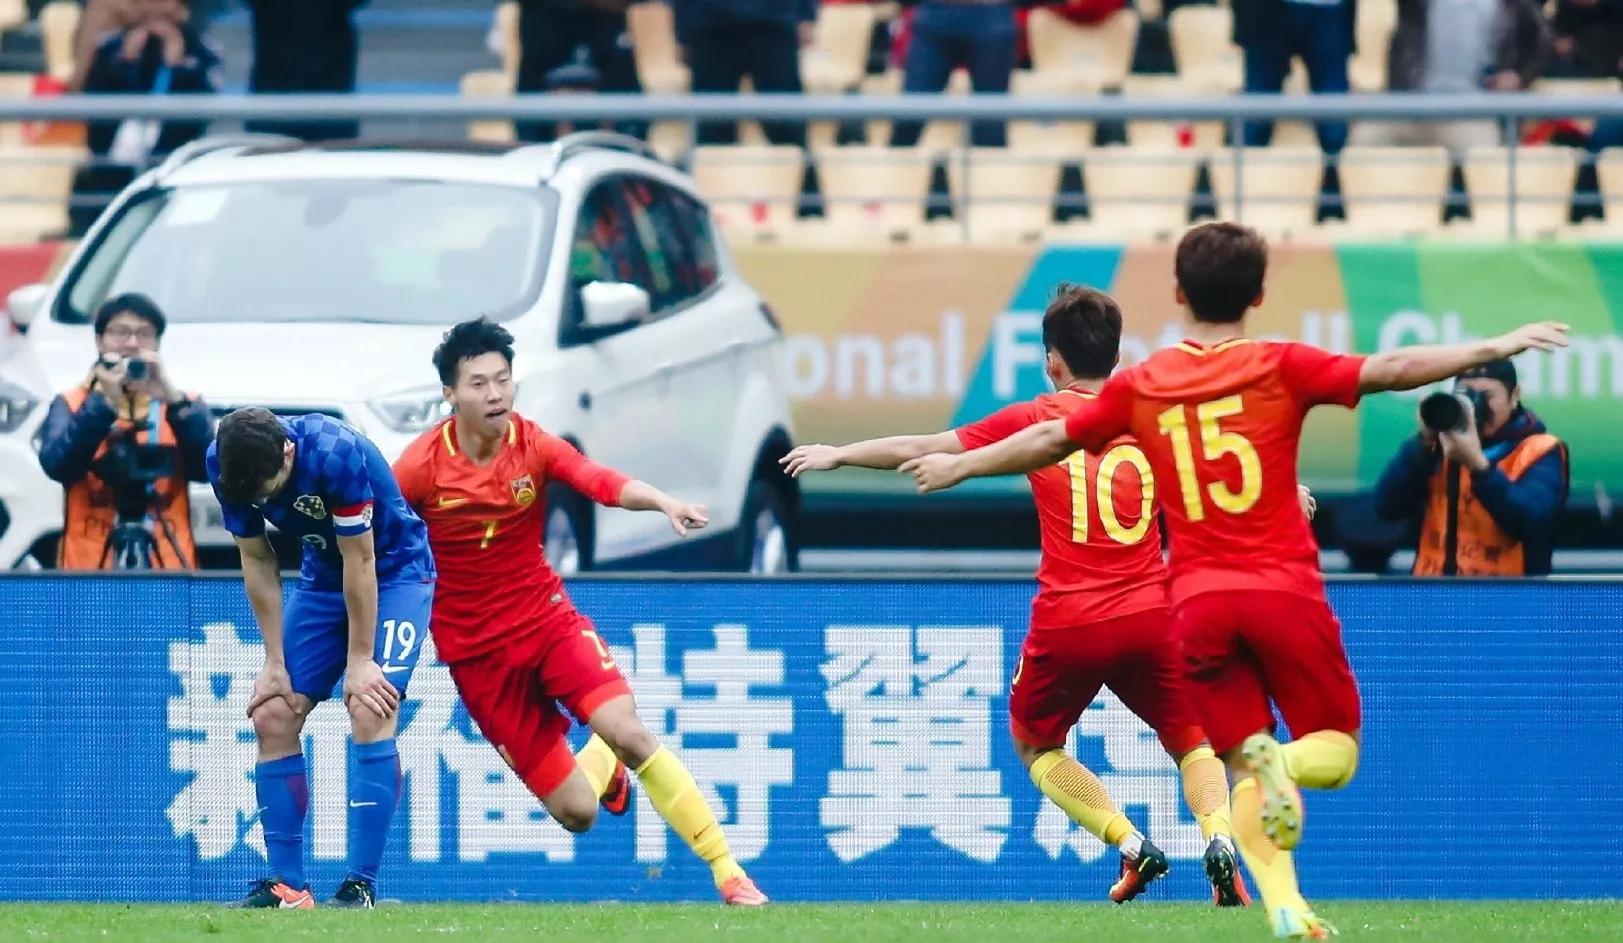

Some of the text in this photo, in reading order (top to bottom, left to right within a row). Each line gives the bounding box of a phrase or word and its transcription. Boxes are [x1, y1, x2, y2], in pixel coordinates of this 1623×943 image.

[1157, 394, 1263, 522] 15
[1058, 444, 1154, 545] 10
[481, 519, 497, 549] 7
[382, 619, 417, 661] 19
